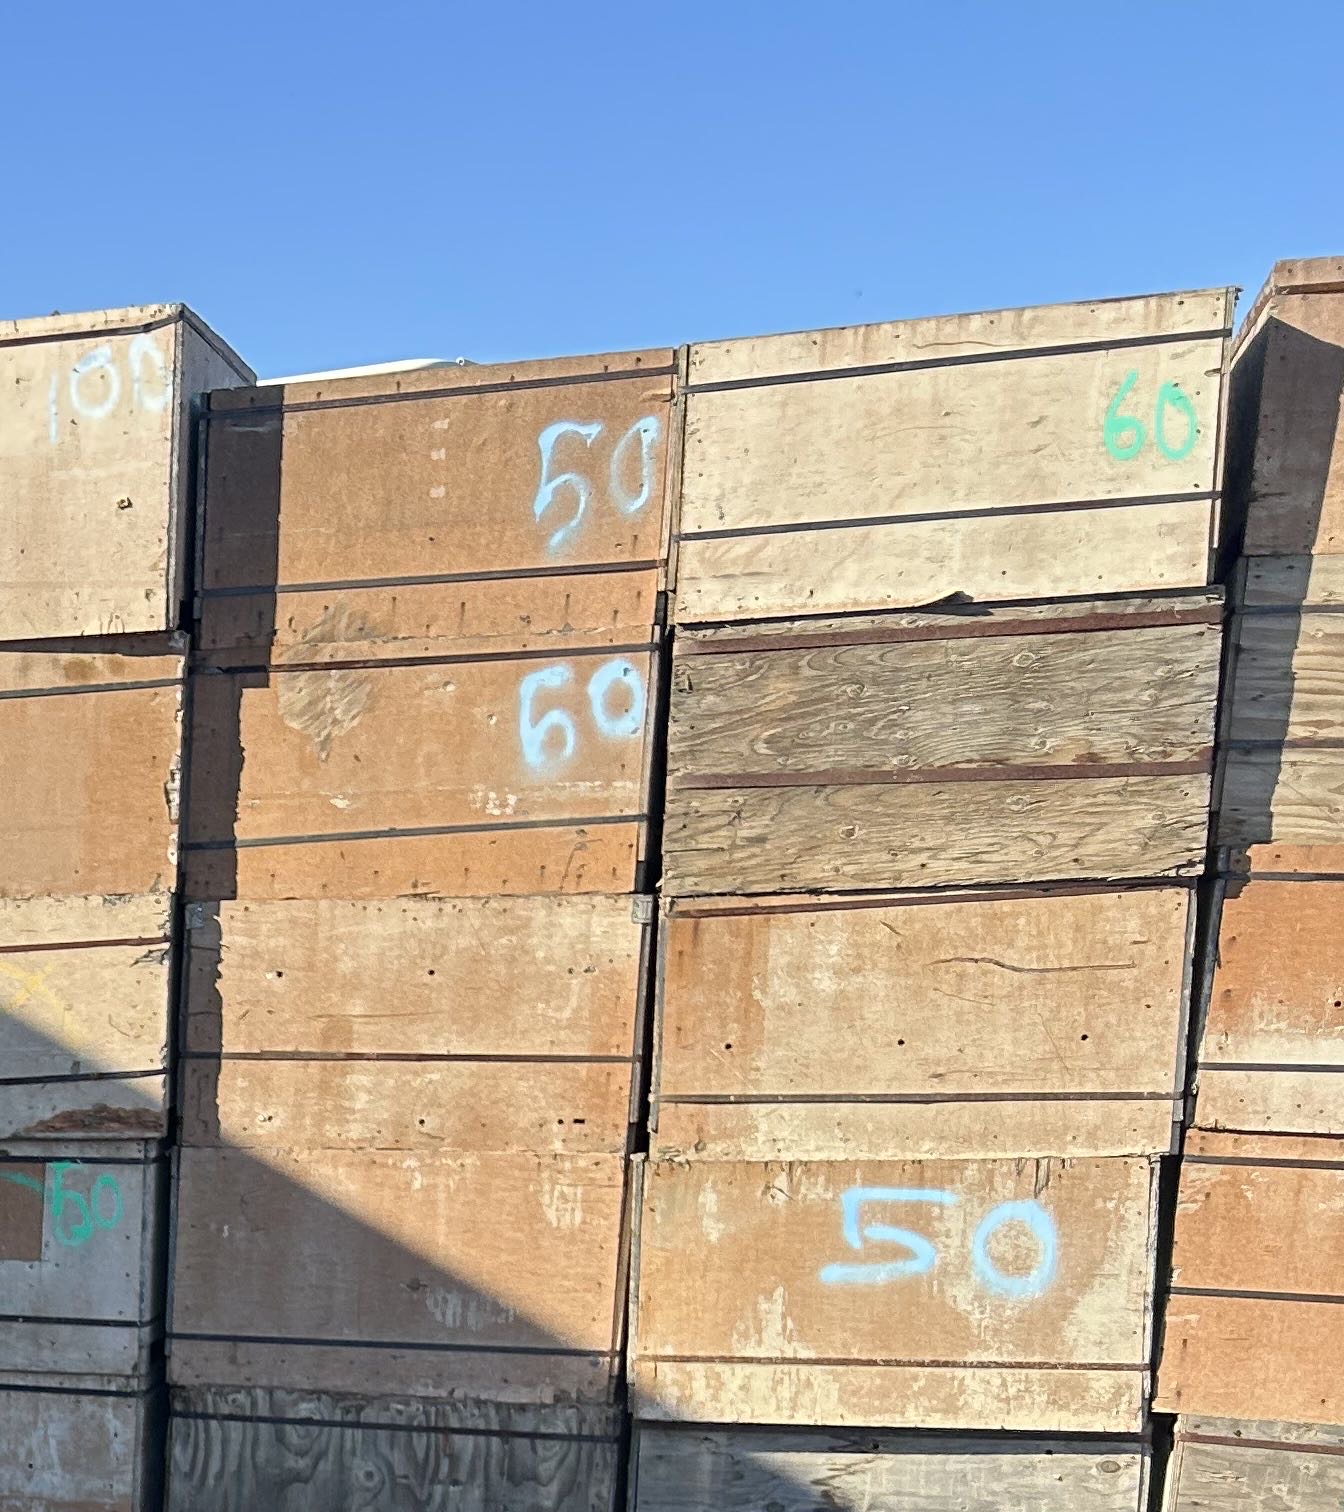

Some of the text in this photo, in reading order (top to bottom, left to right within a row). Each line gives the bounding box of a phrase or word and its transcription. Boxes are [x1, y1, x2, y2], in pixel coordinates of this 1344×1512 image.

[1102, 370, 1200, 462] 60
[531, 415, 661, 557] 50
[819, 1185, 1058, 1300] 50
